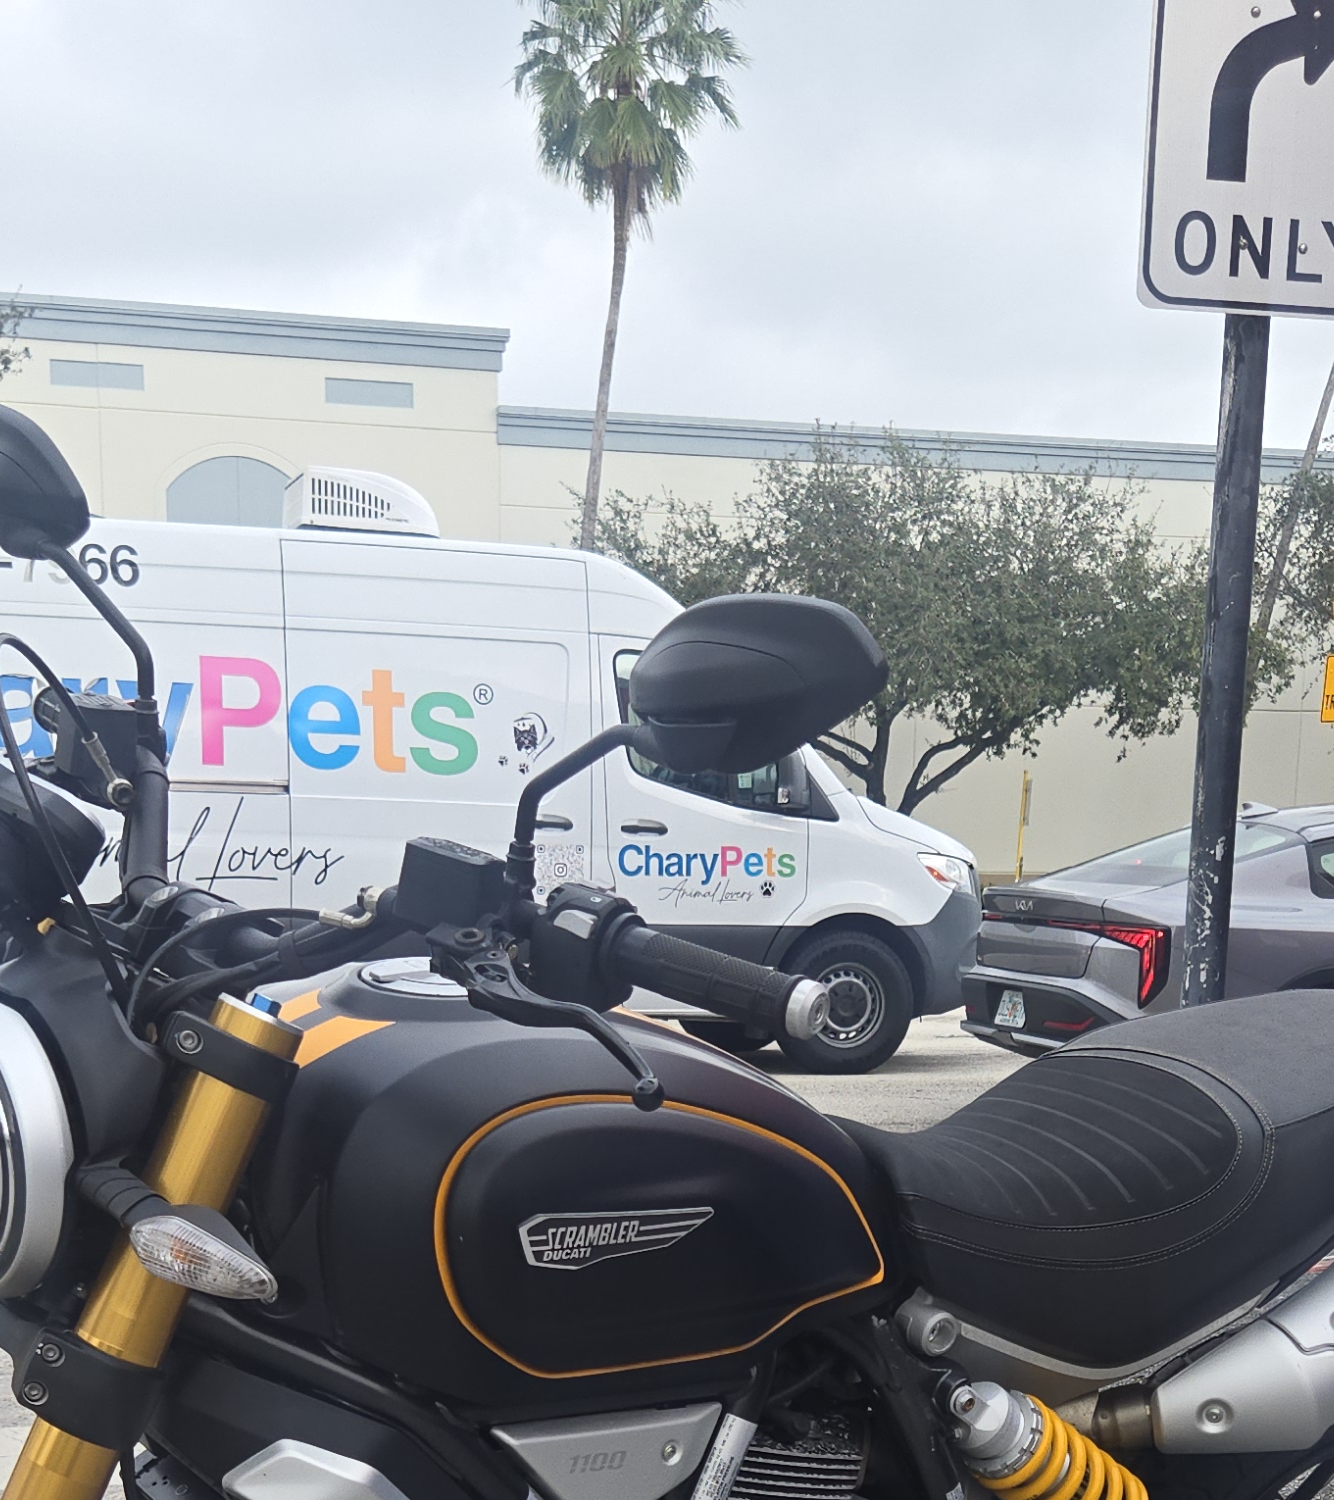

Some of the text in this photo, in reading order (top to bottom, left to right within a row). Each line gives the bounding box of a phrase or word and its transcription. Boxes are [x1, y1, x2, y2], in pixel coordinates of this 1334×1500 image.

[196, 797, 344, 891] Lovers
[619, 844, 796, 886] CharyPets
[658, 878, 755, 908] Animal Lovers
[546, 1220, 640, 1251] SCRAMBLER
[542, 1247, 592, 1262] DUCATI
[569, 1450, 627, 1474] 1100
